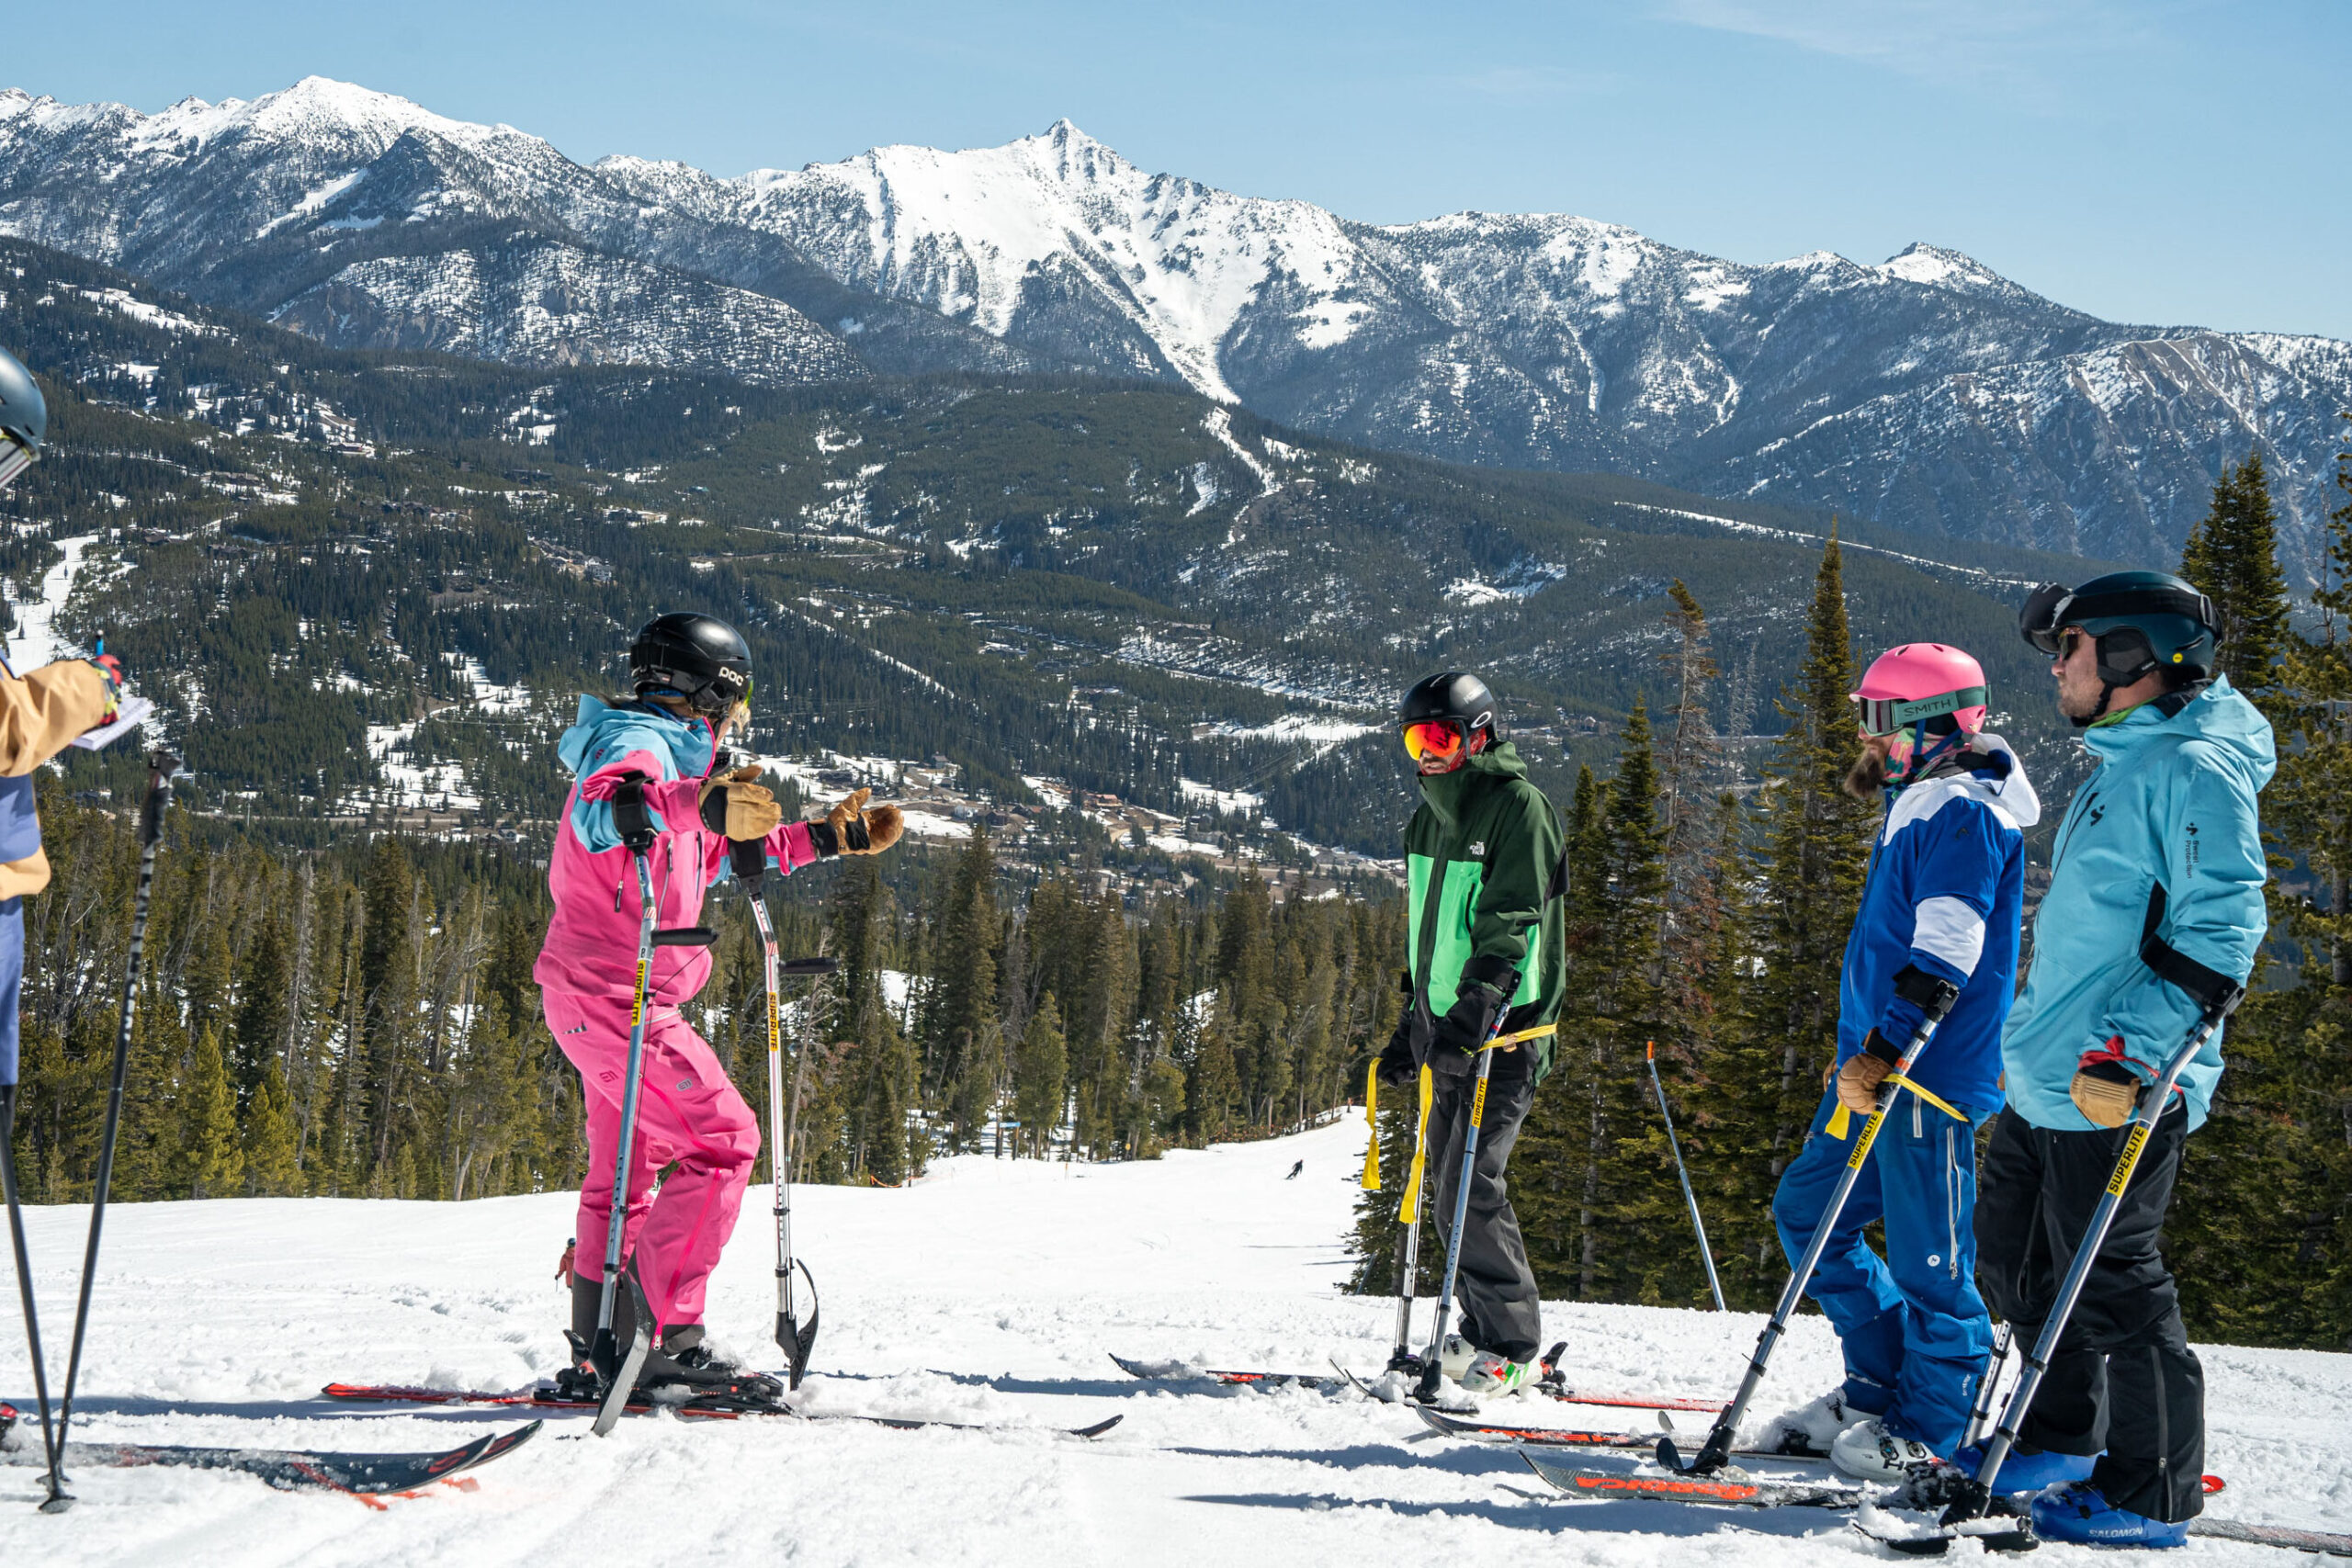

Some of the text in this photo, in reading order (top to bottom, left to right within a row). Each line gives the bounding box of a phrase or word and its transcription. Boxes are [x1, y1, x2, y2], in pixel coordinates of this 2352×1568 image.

[1904, 698, 1951, 716] SMITH
[632, 962, 644, 1023] SUPERLITE
[769, 994, 777, 1049] SUPERLITE
[1473, 1077, 1486, 1126] SUPERLITE
[1849, 1113, 1878, 1166] SUPERLITE
[2109, 1127, 2144, 1193] SUPERLITE
[2088, 1526, 2143, 1539] SALOMON
